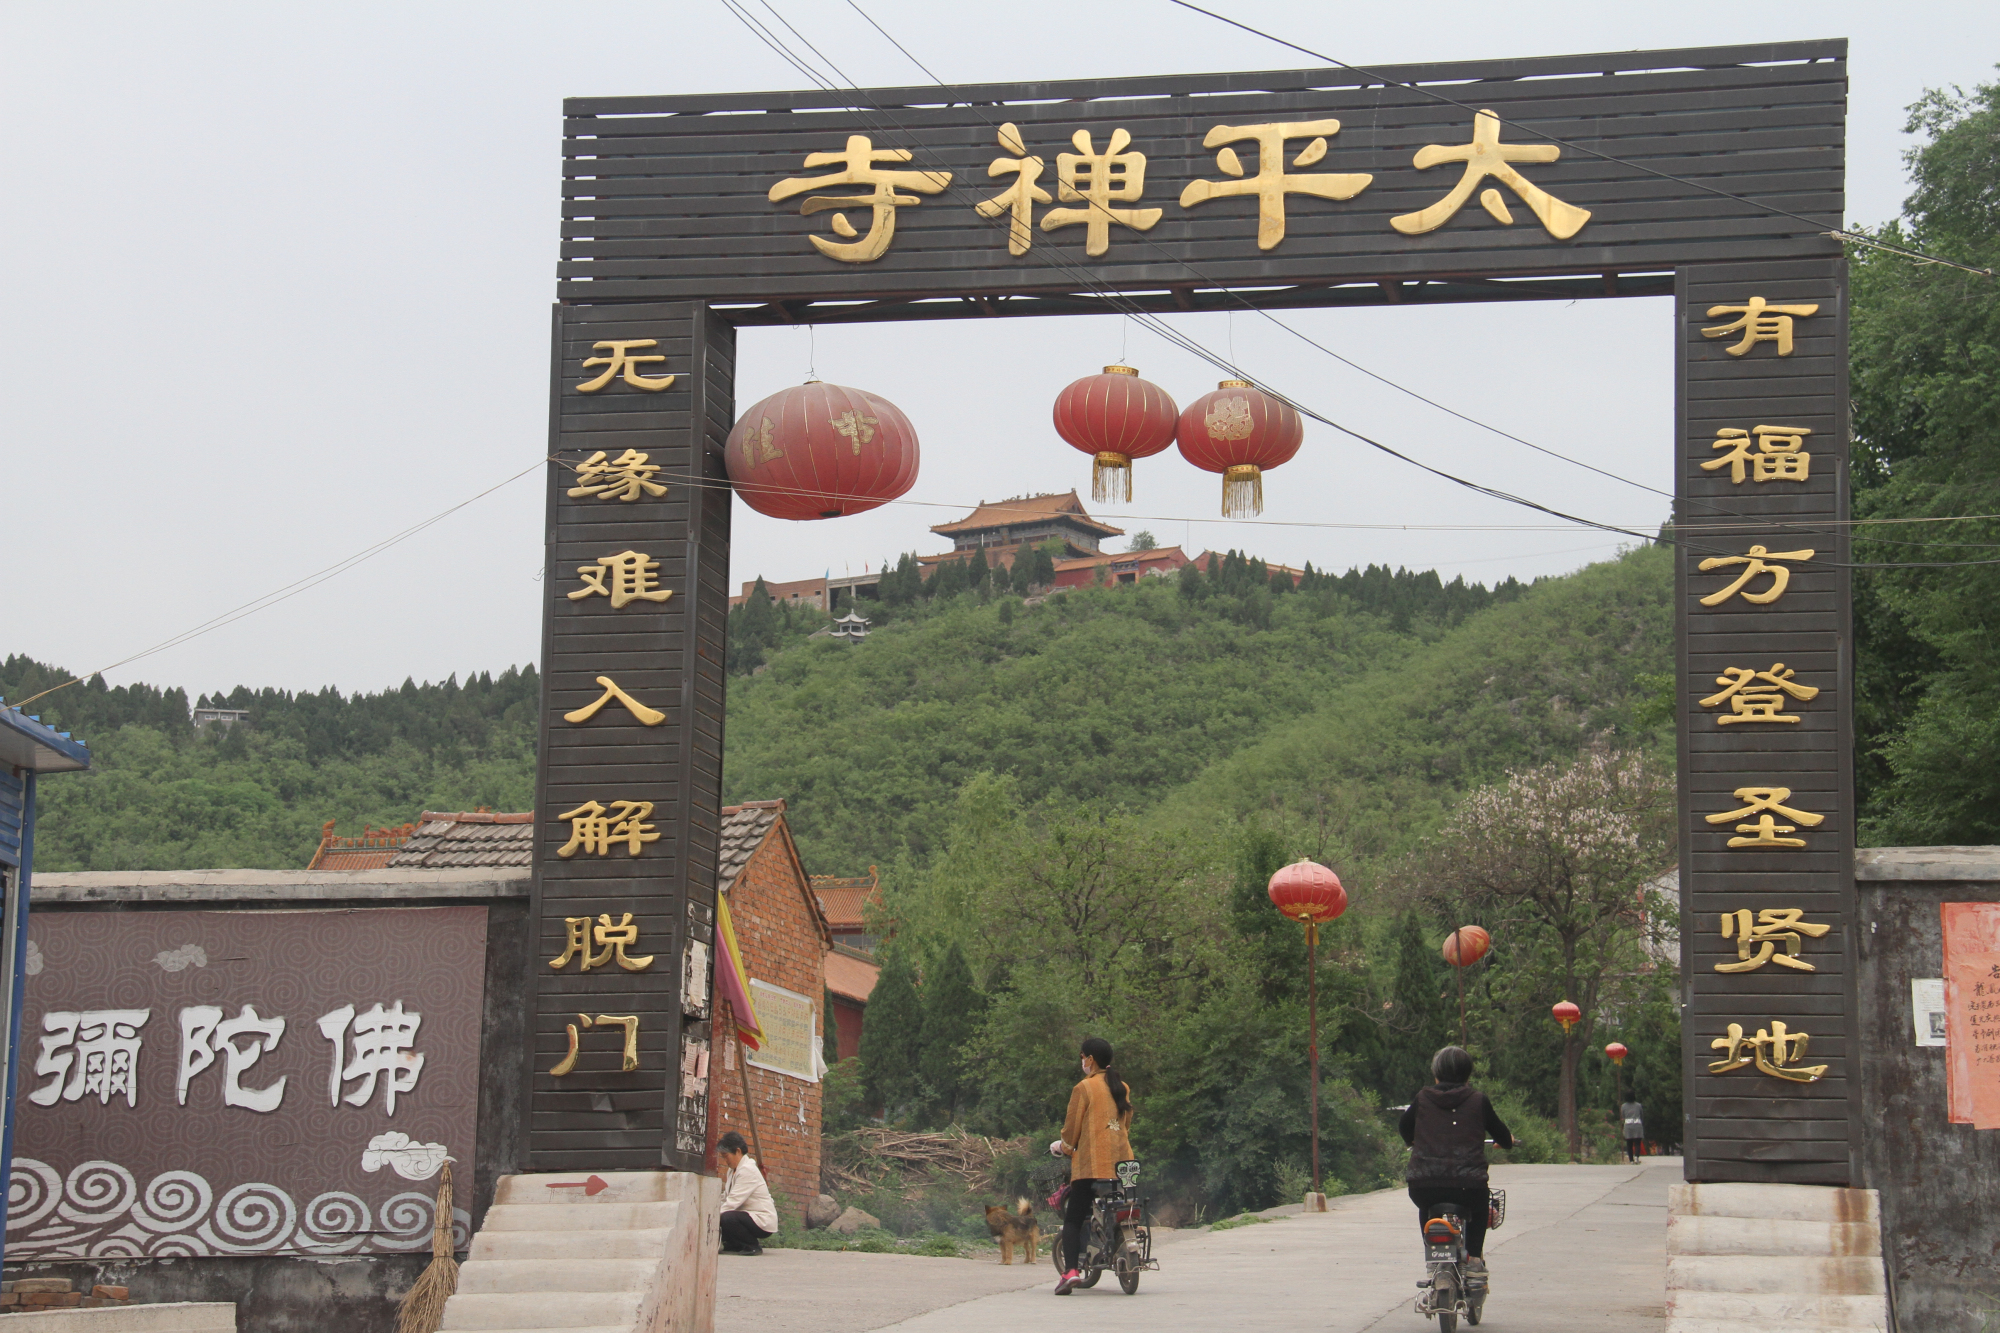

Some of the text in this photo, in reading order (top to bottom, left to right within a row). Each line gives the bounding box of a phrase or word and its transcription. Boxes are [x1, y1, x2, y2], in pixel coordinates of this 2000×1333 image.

[768, 108, 1592, 263] 太平禅寺
[549, 339, 676, 1076] 无缘难入解脱门
[1698, 296, 1831, 1083] 有福方登圣贤地
